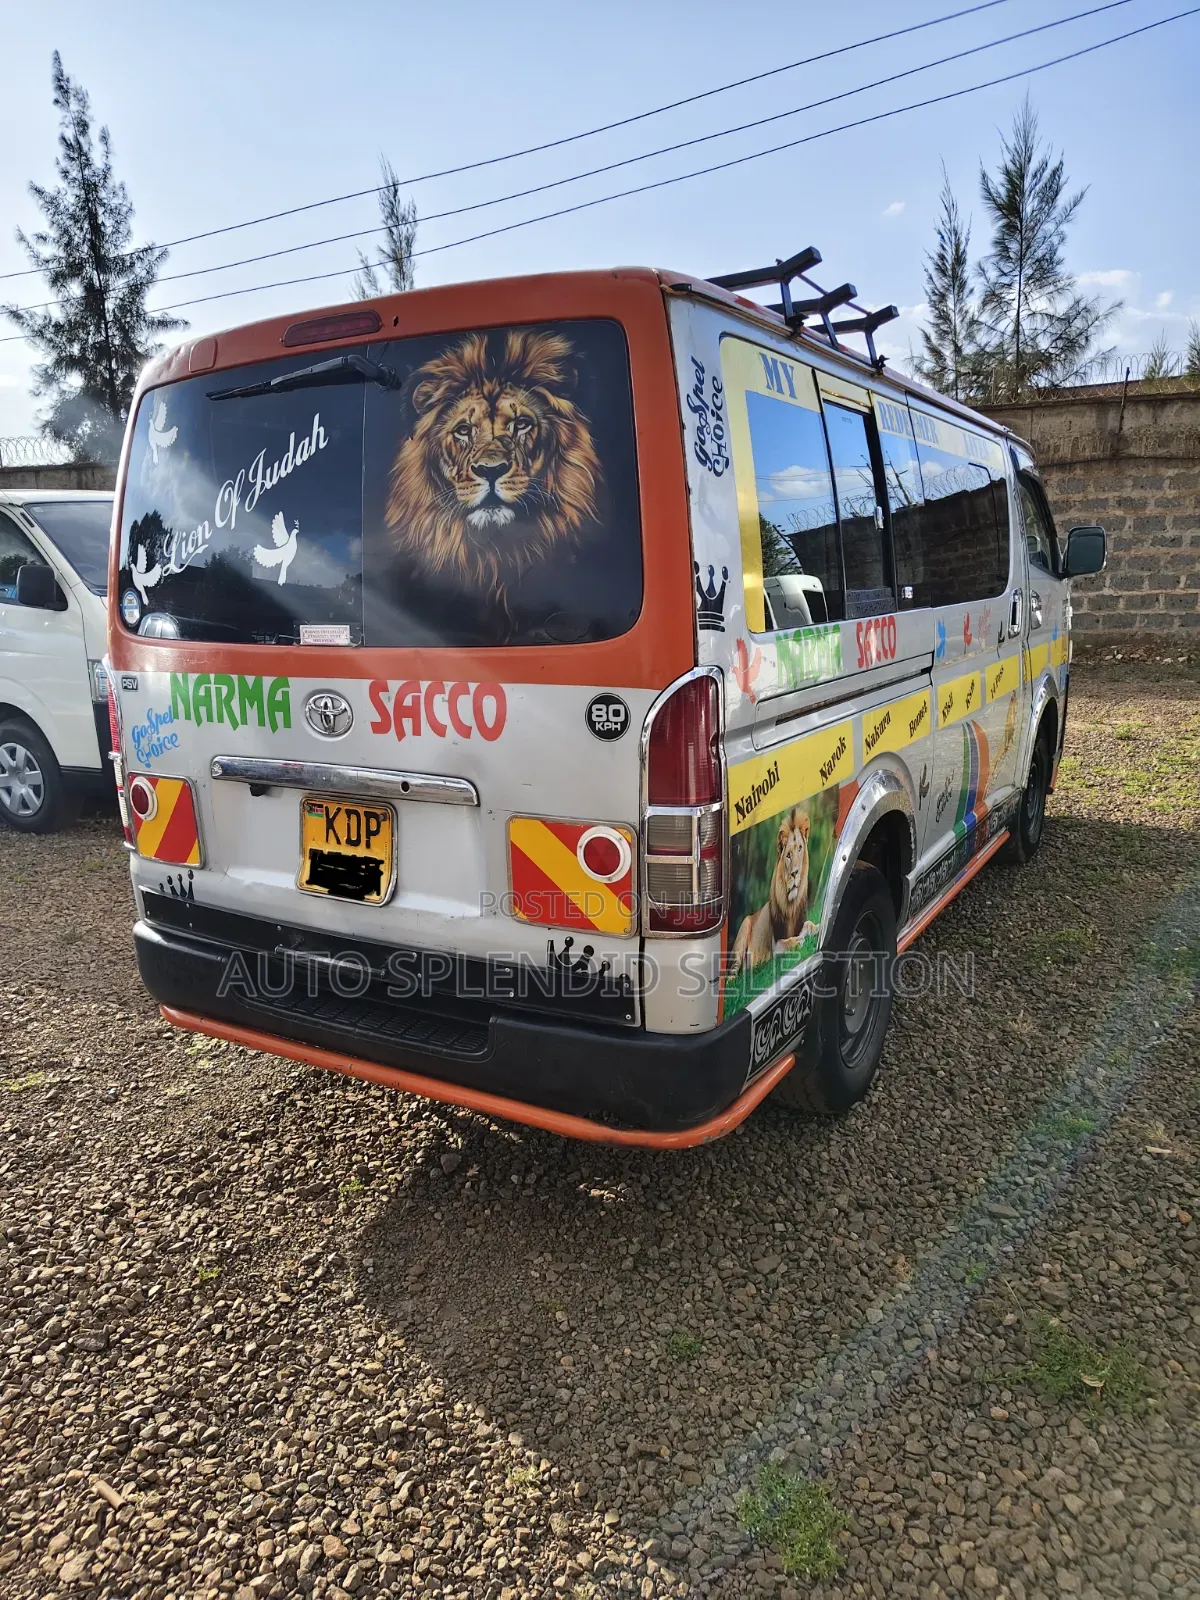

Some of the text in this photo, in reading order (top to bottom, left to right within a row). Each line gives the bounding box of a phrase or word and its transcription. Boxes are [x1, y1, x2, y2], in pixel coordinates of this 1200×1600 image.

[759, 352, 797, 399] MY
[162, 412, 329, 577] Lion Of Judah
[856, 615, 896, 670] SACCO
[122, 676, 138, 691] PSV
[170, 672, 507, 742] NARMA SACCO
[592, 704, 625, 722] 80
[595, 721, 621, 731] KPH
[734, 760, 781, 826] Nairobi
[819, 735, 847, 787] Narok
[908, 699, 928, 739] Bomet
[325, 806, 381, 849] KDP
